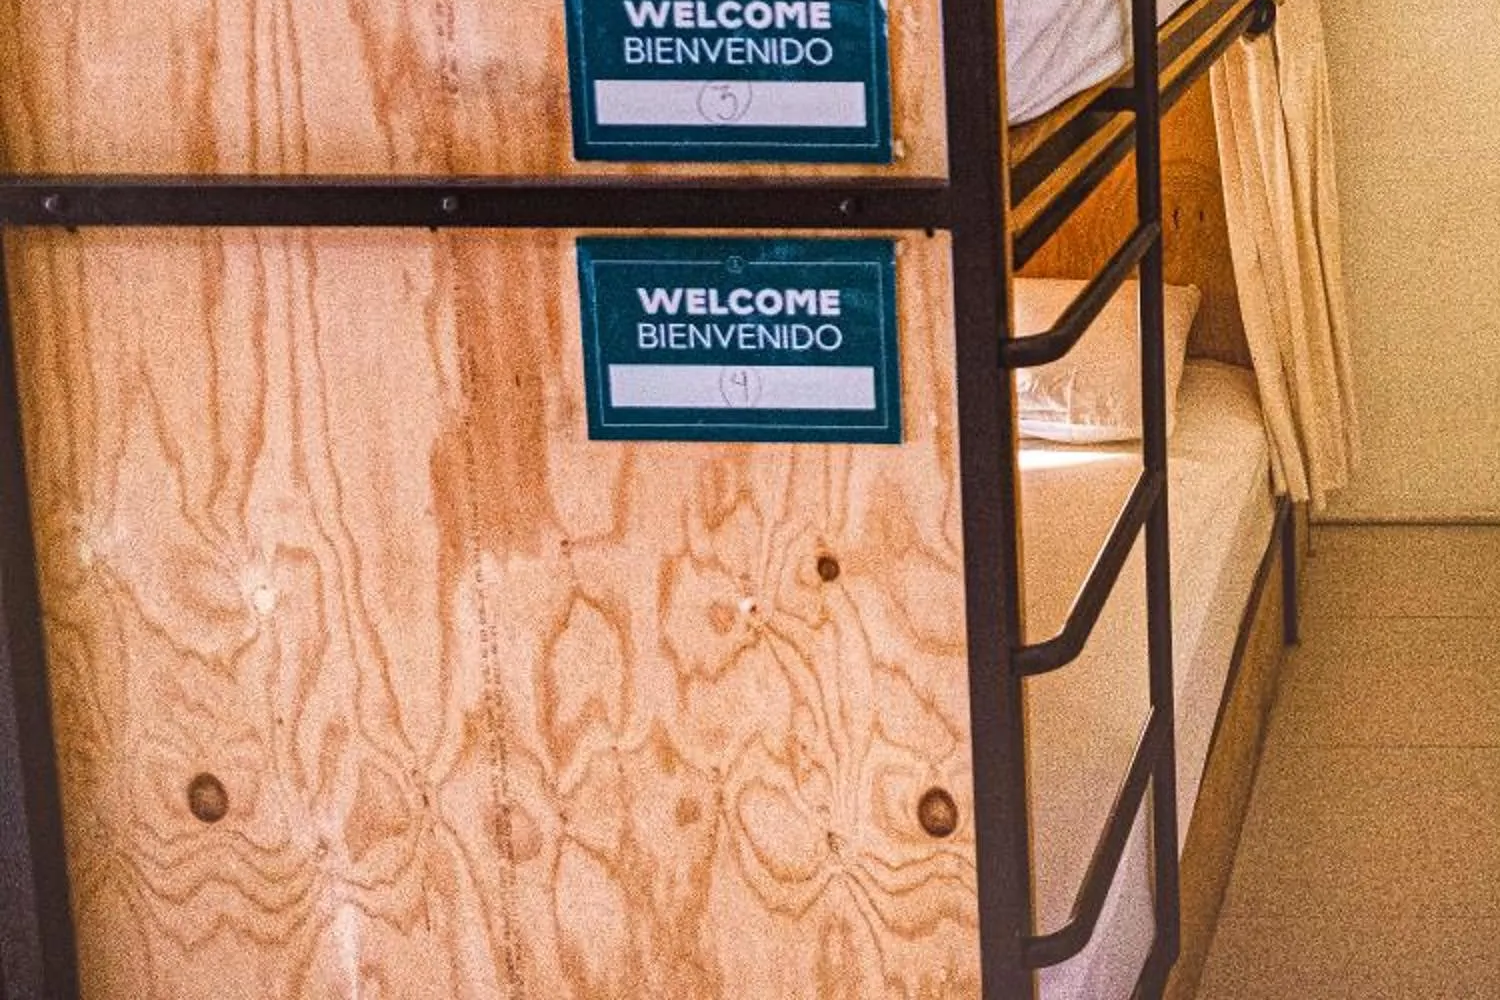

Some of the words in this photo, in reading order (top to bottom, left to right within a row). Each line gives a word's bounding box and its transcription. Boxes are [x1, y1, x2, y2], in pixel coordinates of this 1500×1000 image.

[623, 0, 831, 29] WELCOME
[624, 37, 833, 65] BIENVENIDO
[637, 287, 841, 316] WELCOME
[638, 323, 843, 351] BIENVENIDO
